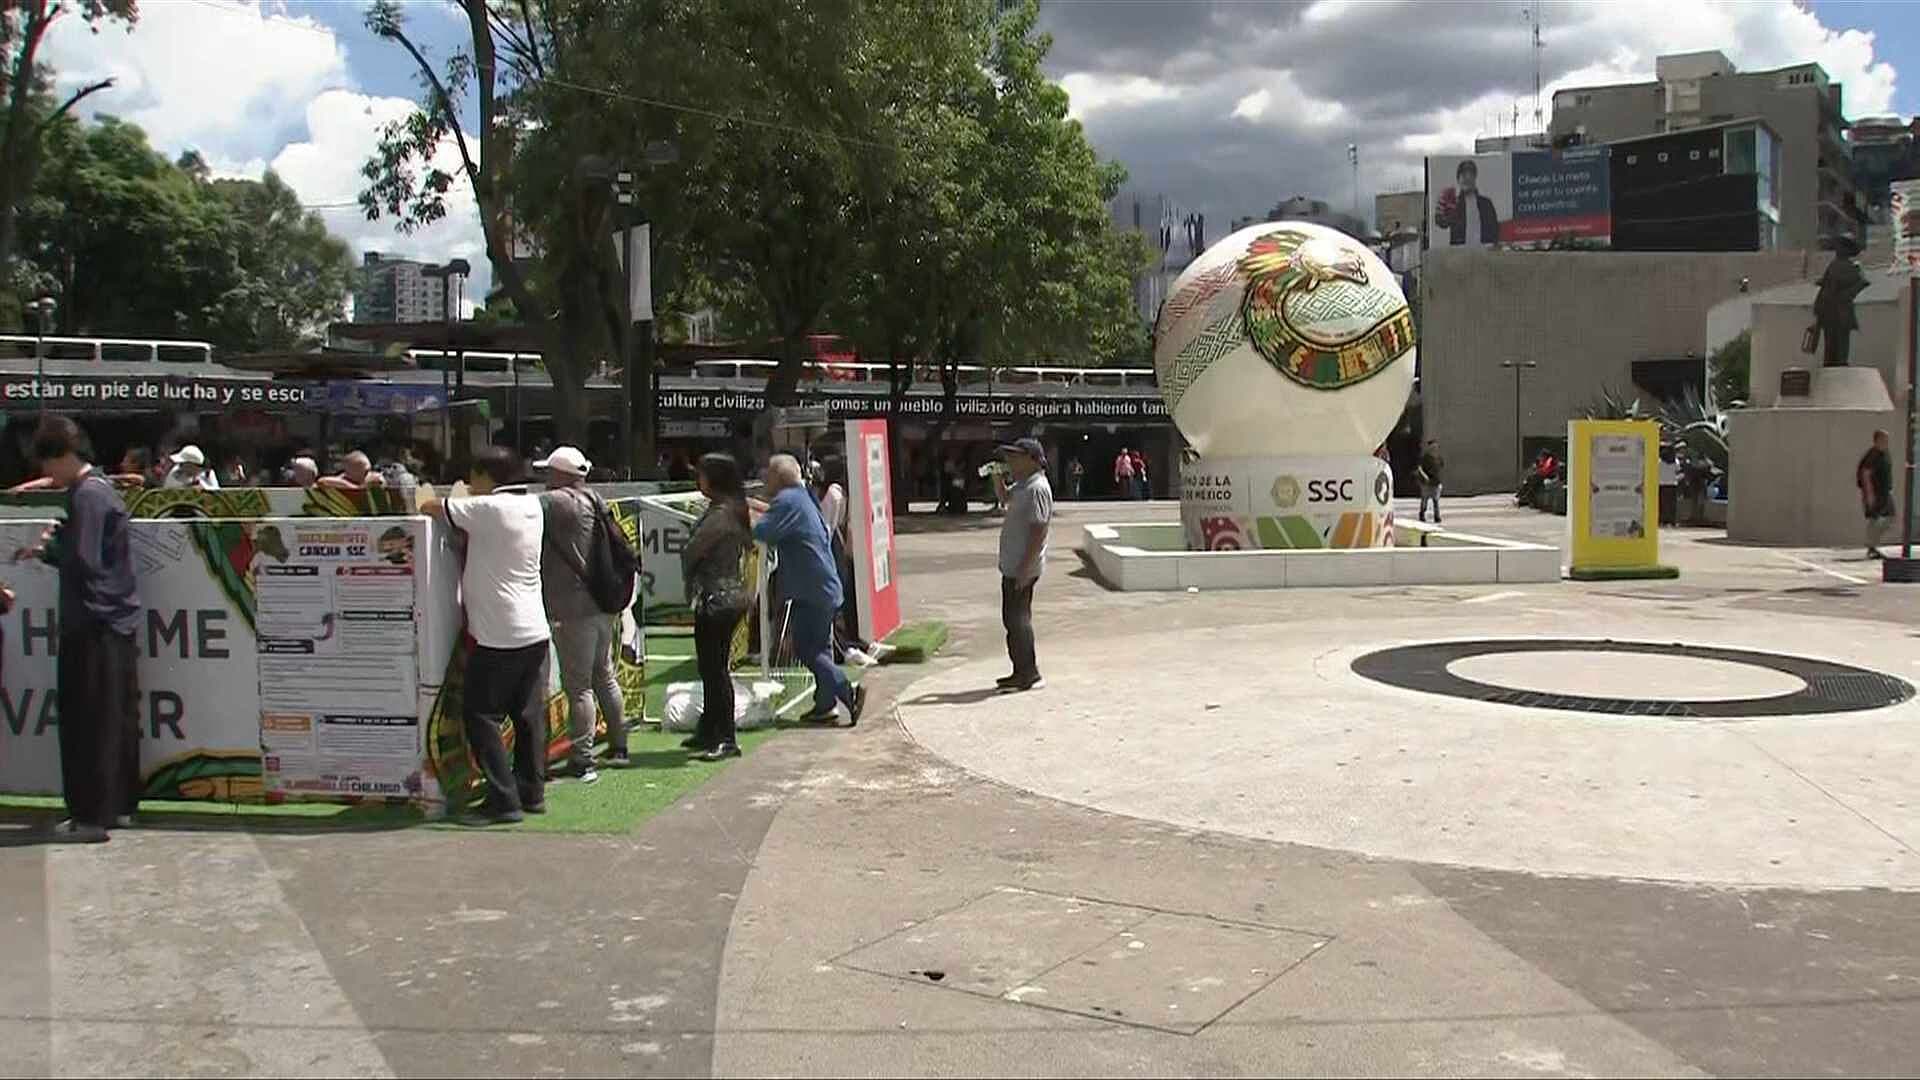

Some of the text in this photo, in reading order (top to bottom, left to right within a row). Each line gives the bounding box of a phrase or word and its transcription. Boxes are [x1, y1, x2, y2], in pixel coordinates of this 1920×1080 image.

[4, 380, 64, 398] están
[71, 383, 95, 397] en
[101, 381, 129, 400] pie
[136, 381, 158, 398] de
[164, 381, 217, 399] lucha
[222, 386, 234, 404] y
[241, 386, 262, 400] se
[714, 394, 764, 409] civiliza
[874, 401, 891, 412] un
[955, 399, 1014, 414] ivilizado
[1075, 401, 1137, 415] habiendo
[1142, 401, 1169, 415] tam
[1215, 475, 1231, 487] LA
[1307, 479, 1353, 502] SSC
[21, 606, 231, 660] HME
[0, 686, 186, 741] VAR
